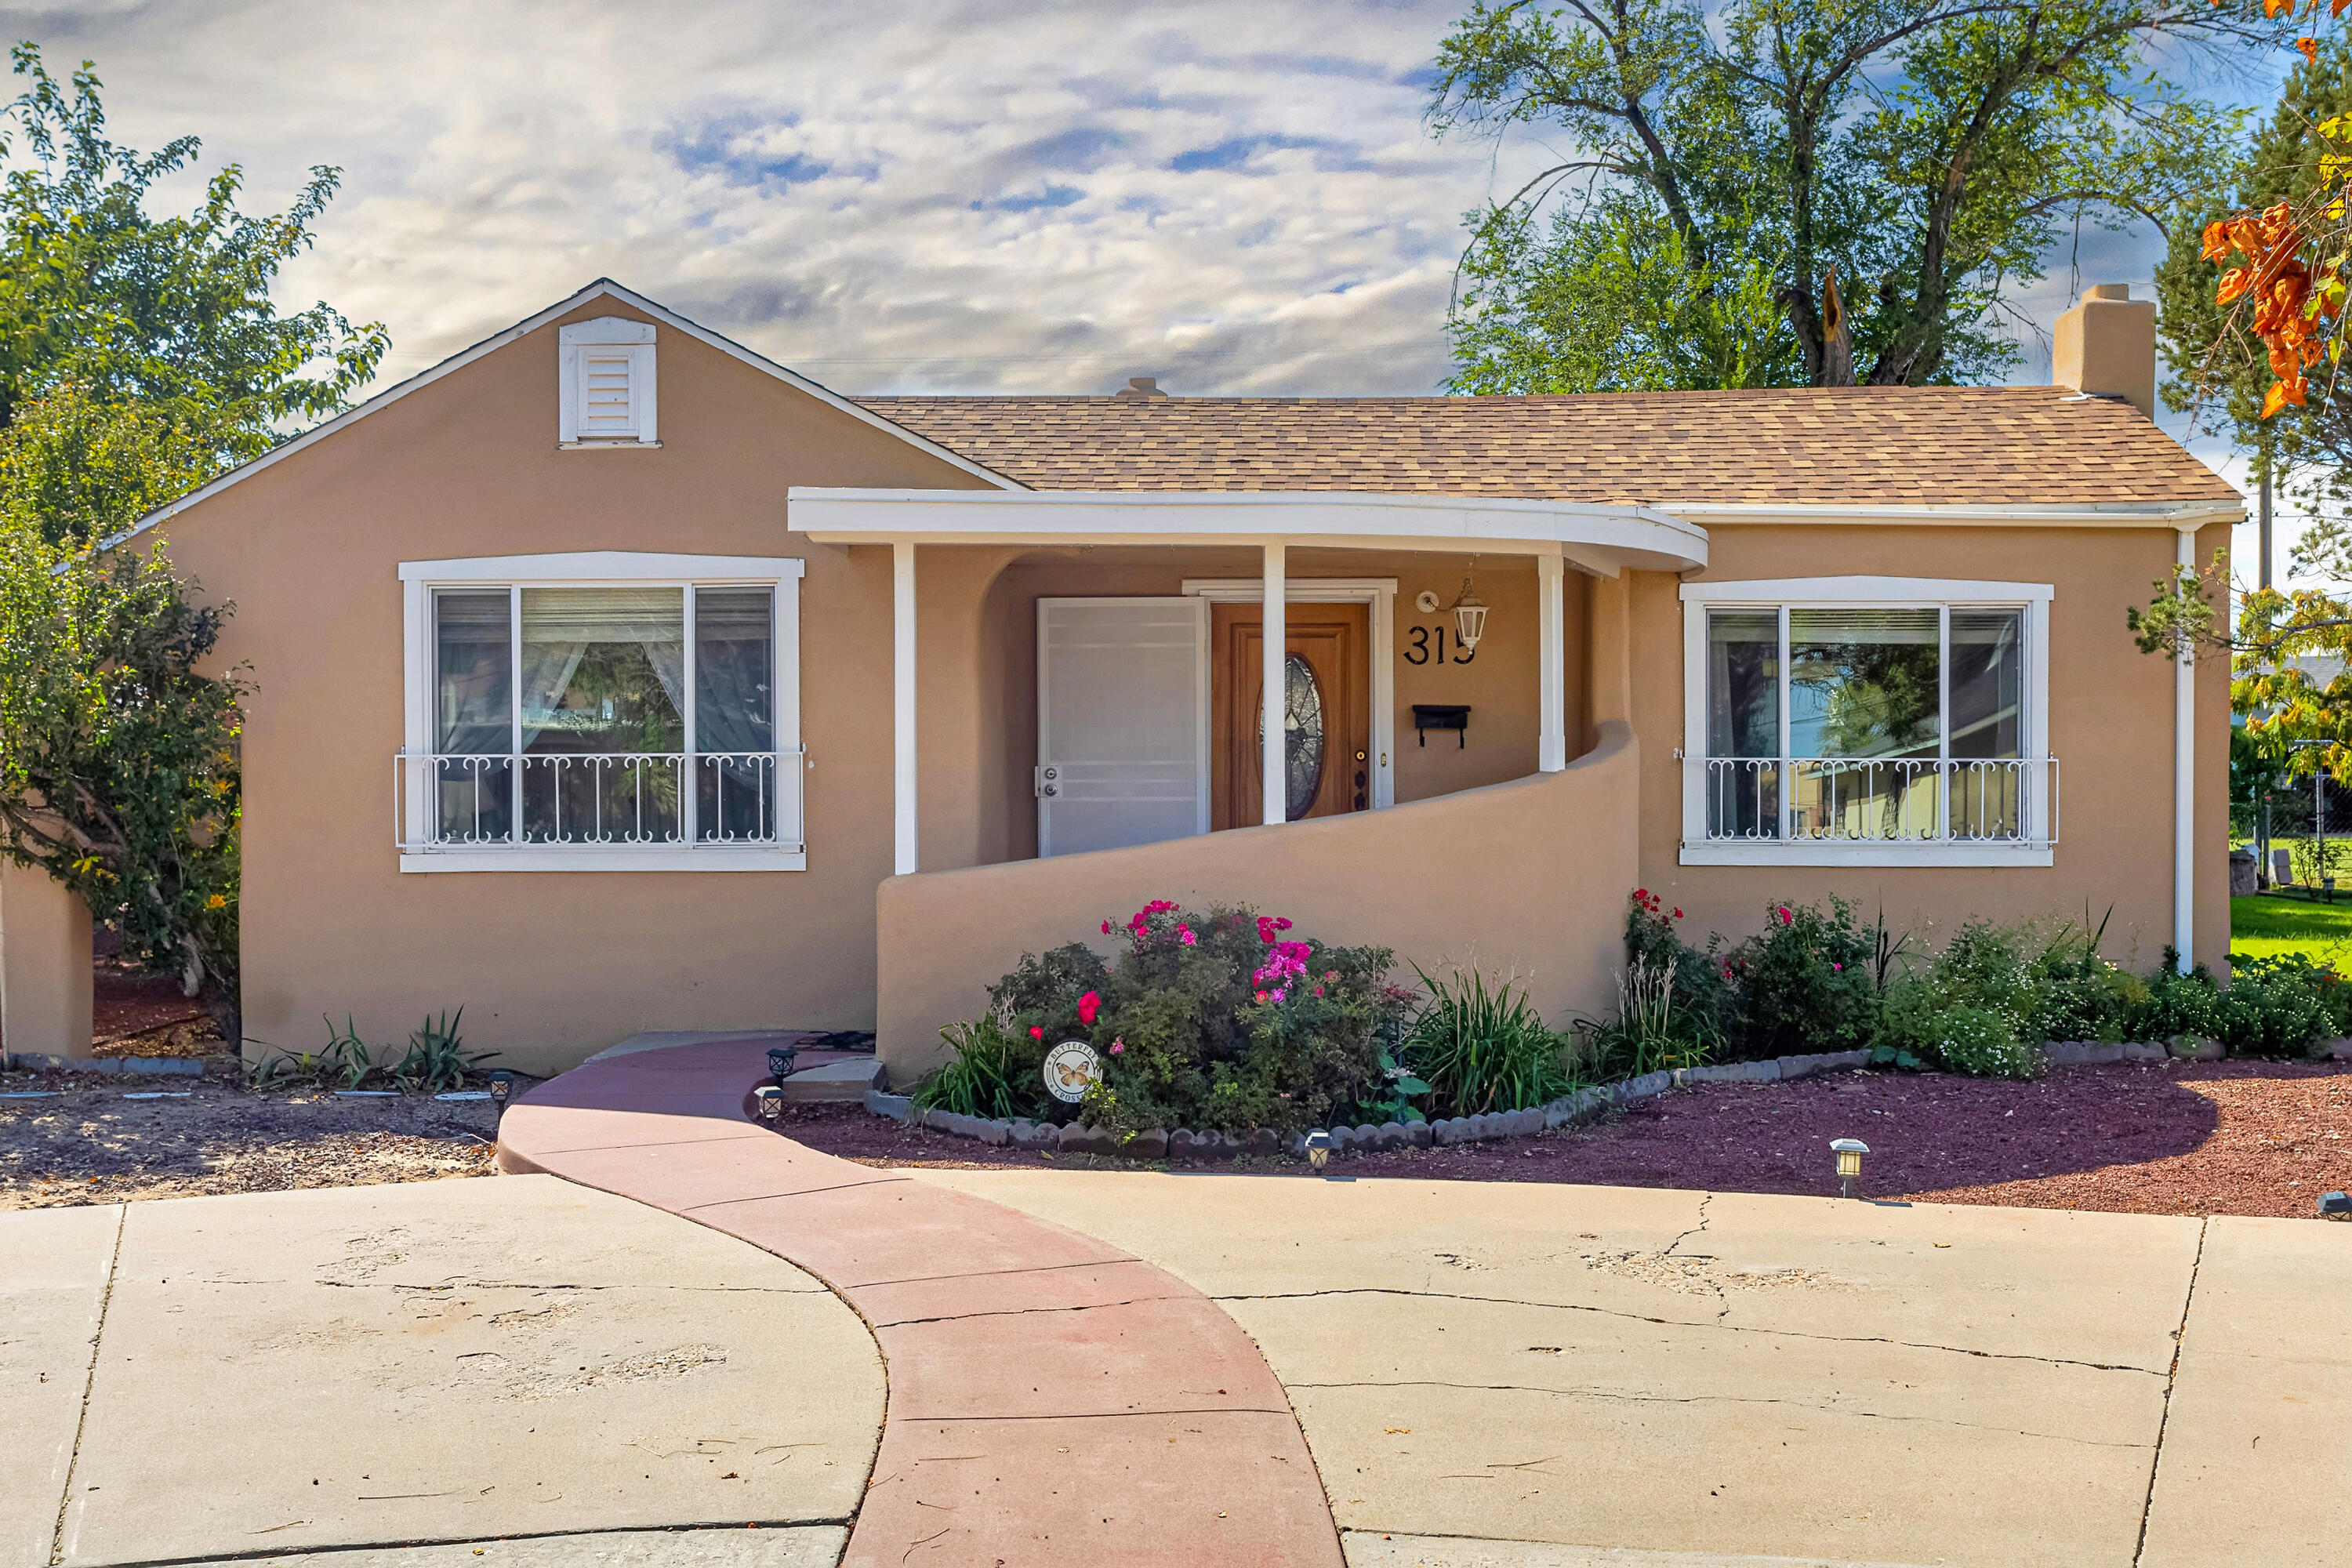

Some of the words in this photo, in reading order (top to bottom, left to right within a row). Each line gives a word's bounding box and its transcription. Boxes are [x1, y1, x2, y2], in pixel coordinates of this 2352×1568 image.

[1403, 626, 1475, 665] 315
[1051, 1043, 1097, 1059] BUTTERFLY
[1054, 1089, 1084, 1102] CROSS
